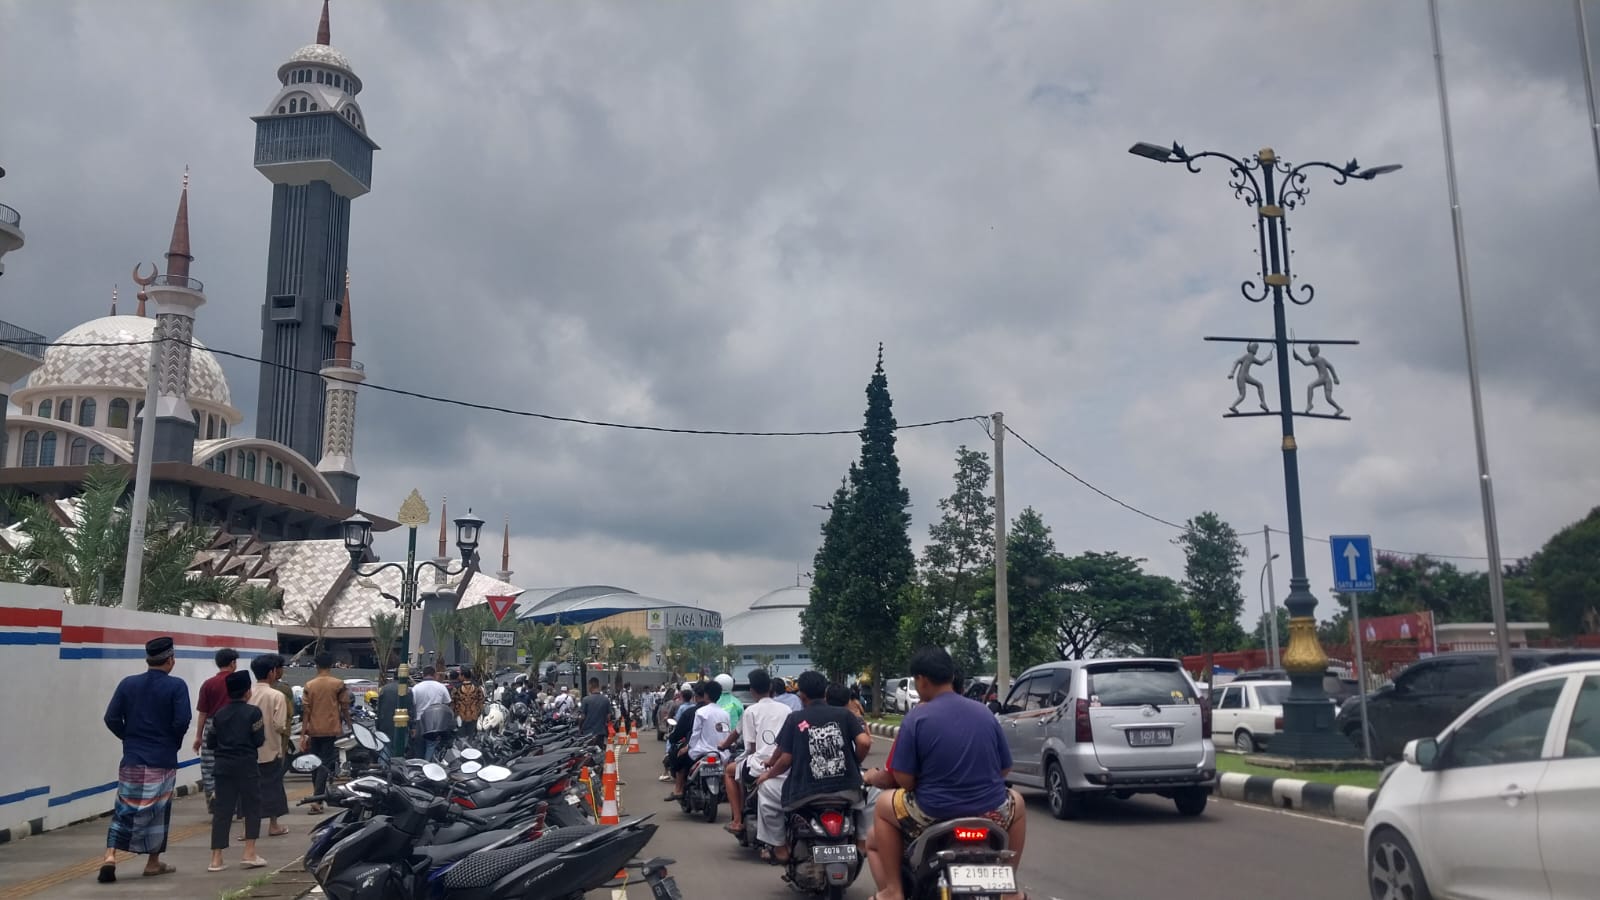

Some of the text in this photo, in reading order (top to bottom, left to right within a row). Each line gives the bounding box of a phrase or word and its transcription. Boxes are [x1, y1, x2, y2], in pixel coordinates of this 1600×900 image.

[953, 867, 1010, 878] F 2190 FET
